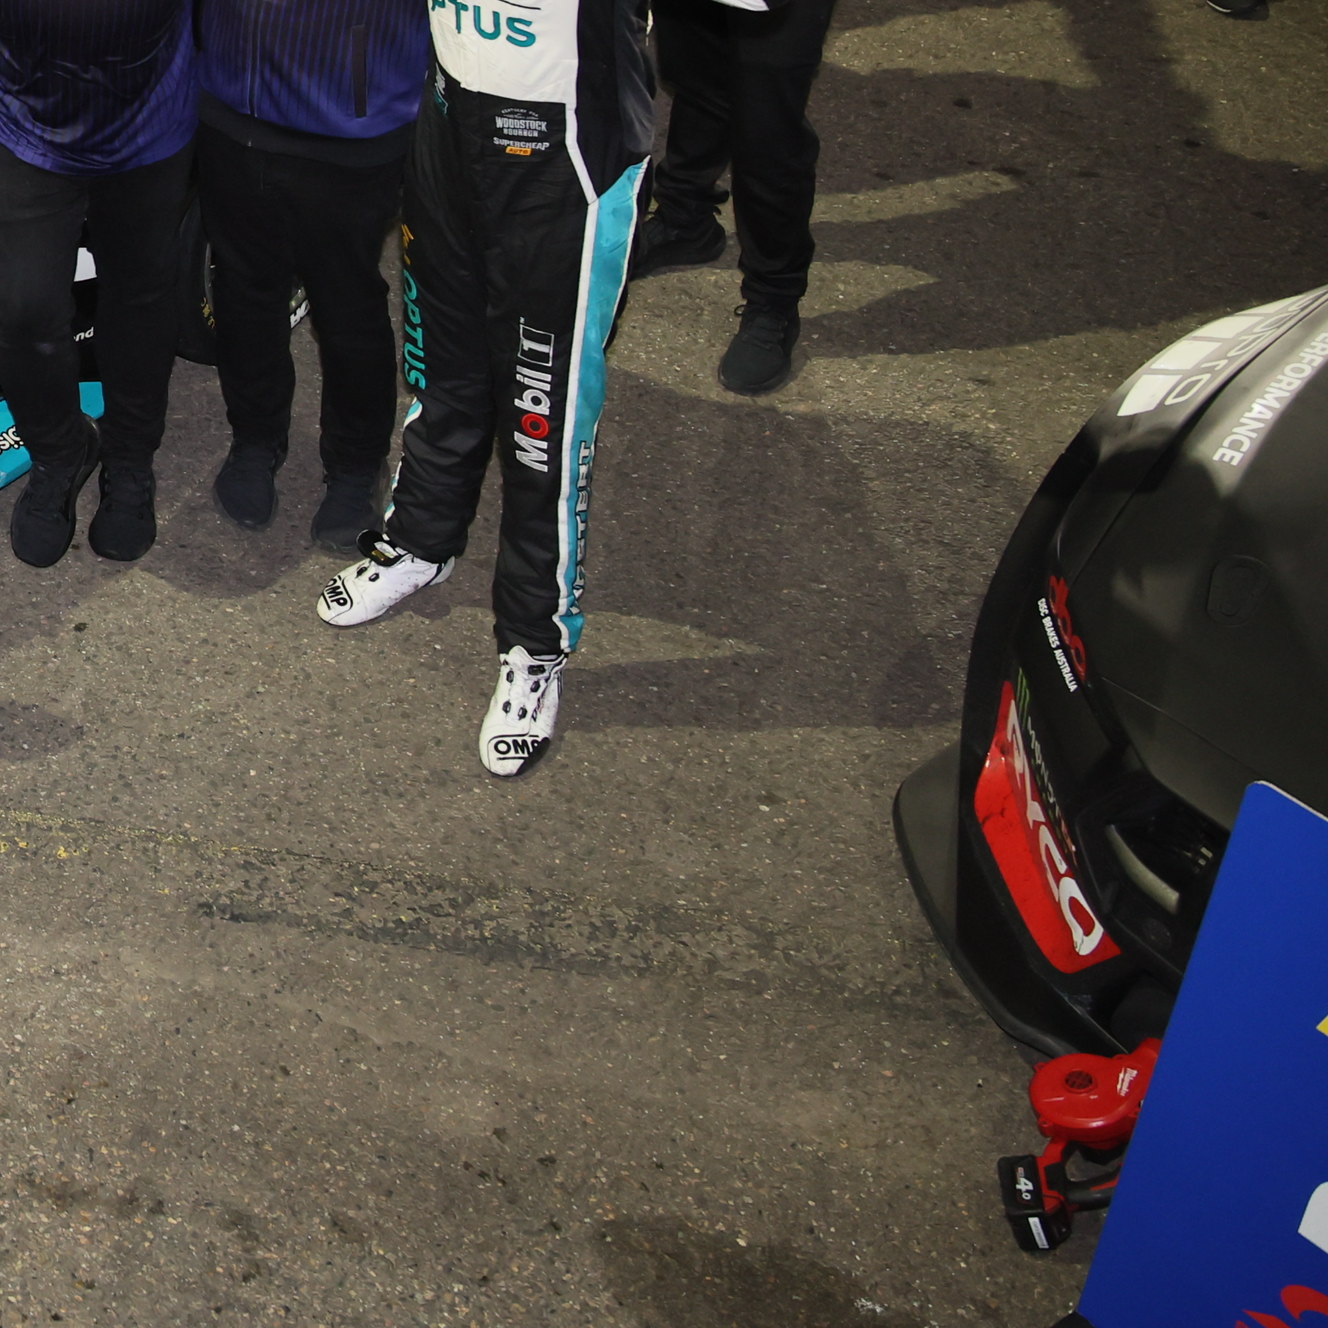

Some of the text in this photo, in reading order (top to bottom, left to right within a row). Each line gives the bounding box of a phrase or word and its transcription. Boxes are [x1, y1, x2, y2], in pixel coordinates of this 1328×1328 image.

[493, 137, 550, 150] SUPERCHEAP
[495, 116, 547, 132] WOODSTOCK
[403, 269, 426, 390] OPTUS
[513, 364, 553, 472] Mobil
[1213, 332, 1328, 467] ERFORMANCE
[1037, 597, 1079, 693] DISC BRAKES AUSTRALIA
